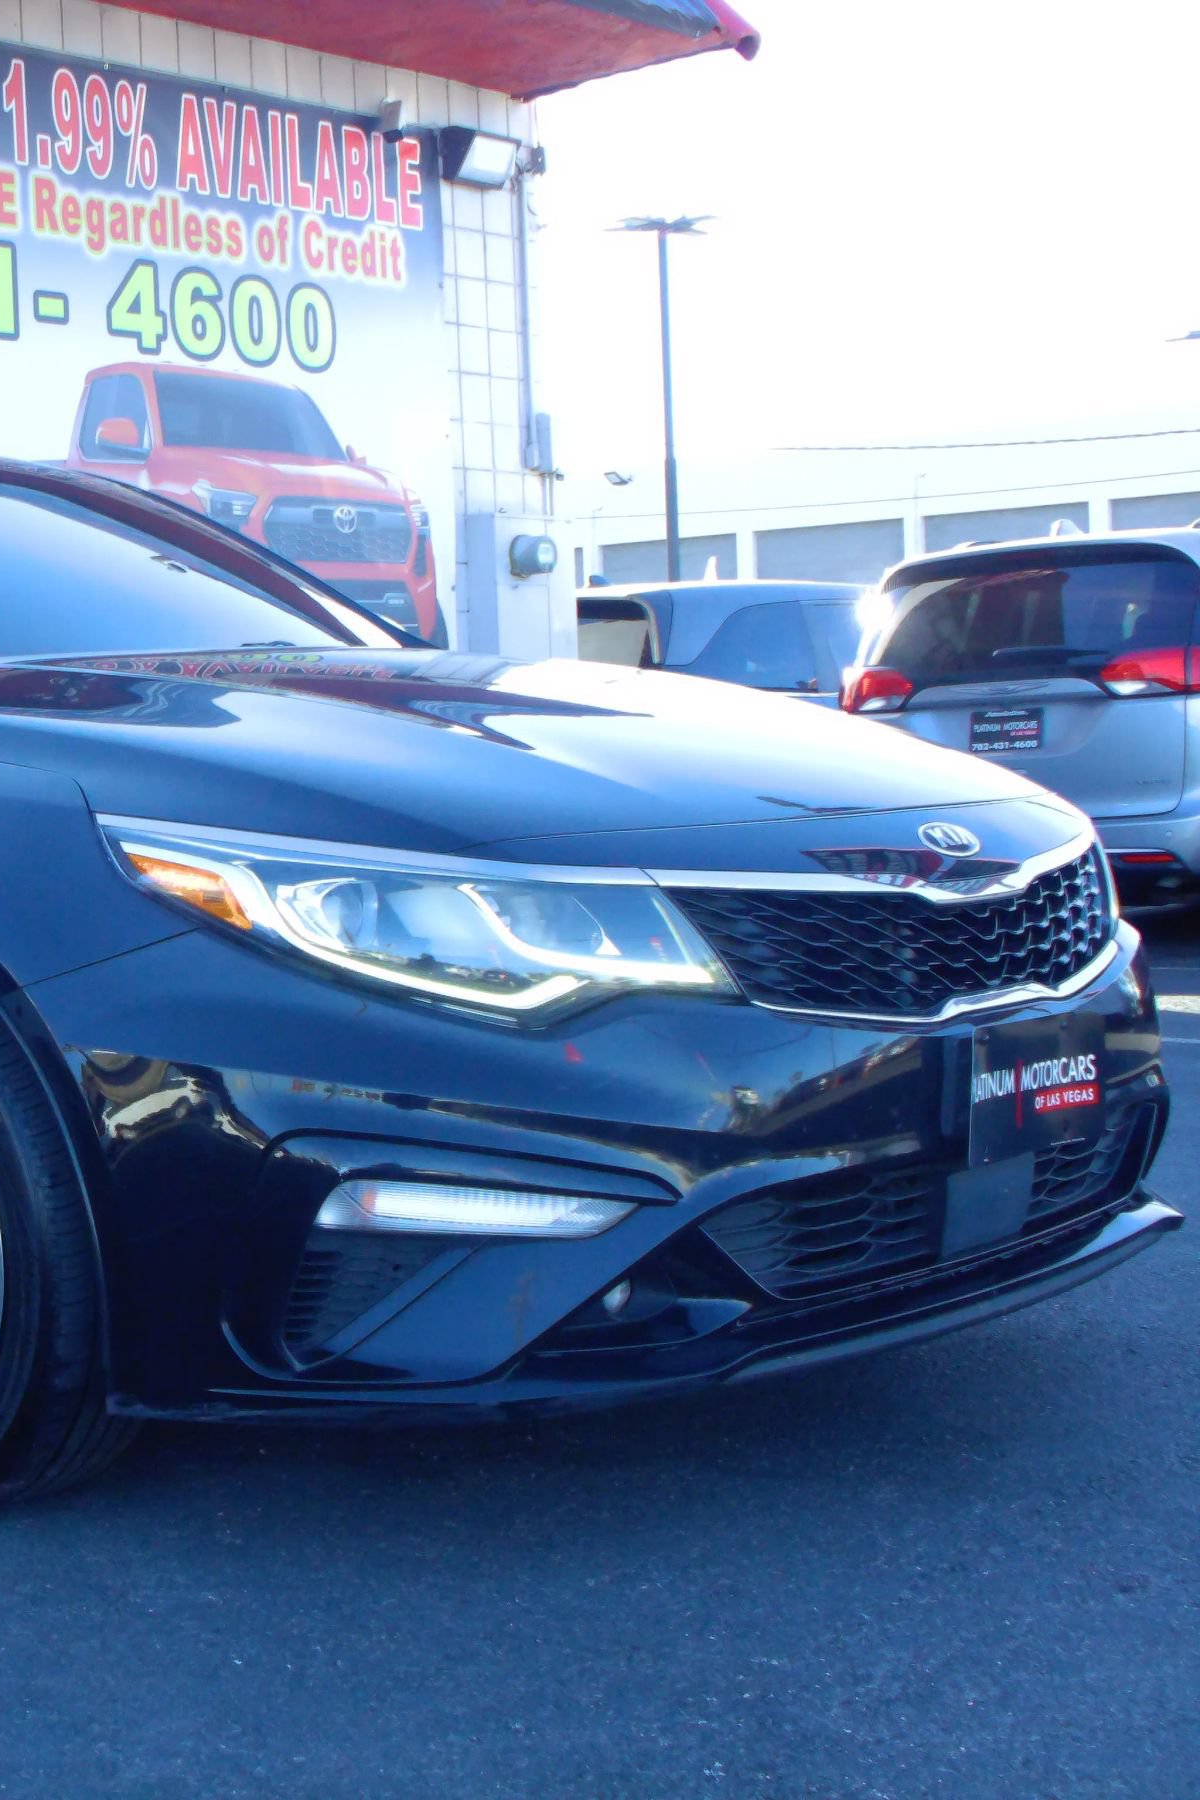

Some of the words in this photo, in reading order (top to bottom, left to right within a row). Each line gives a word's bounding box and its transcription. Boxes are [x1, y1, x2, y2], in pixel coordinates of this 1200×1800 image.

[2, 58, 158, 190] 1.99%
[176, 93, 424, 231] AVAILABLE
[33, 173, 244, 258] Regardless
[256, 214, 292, 265] of
[303, 217, 404, 284] Credit
[106, 258, 337, 373] 4600
[972, 740, 1038, 751] 702-431-4600
[925, 825, 977, 849] KIA
[1021, 1054, 1096, 1092] MOTORCARS
[1034, 1096, 1045, 1109] OF
[1046, 1092, 1060, 1107] LAS
[1063, 1087, 1094, 1103] VEGAS
